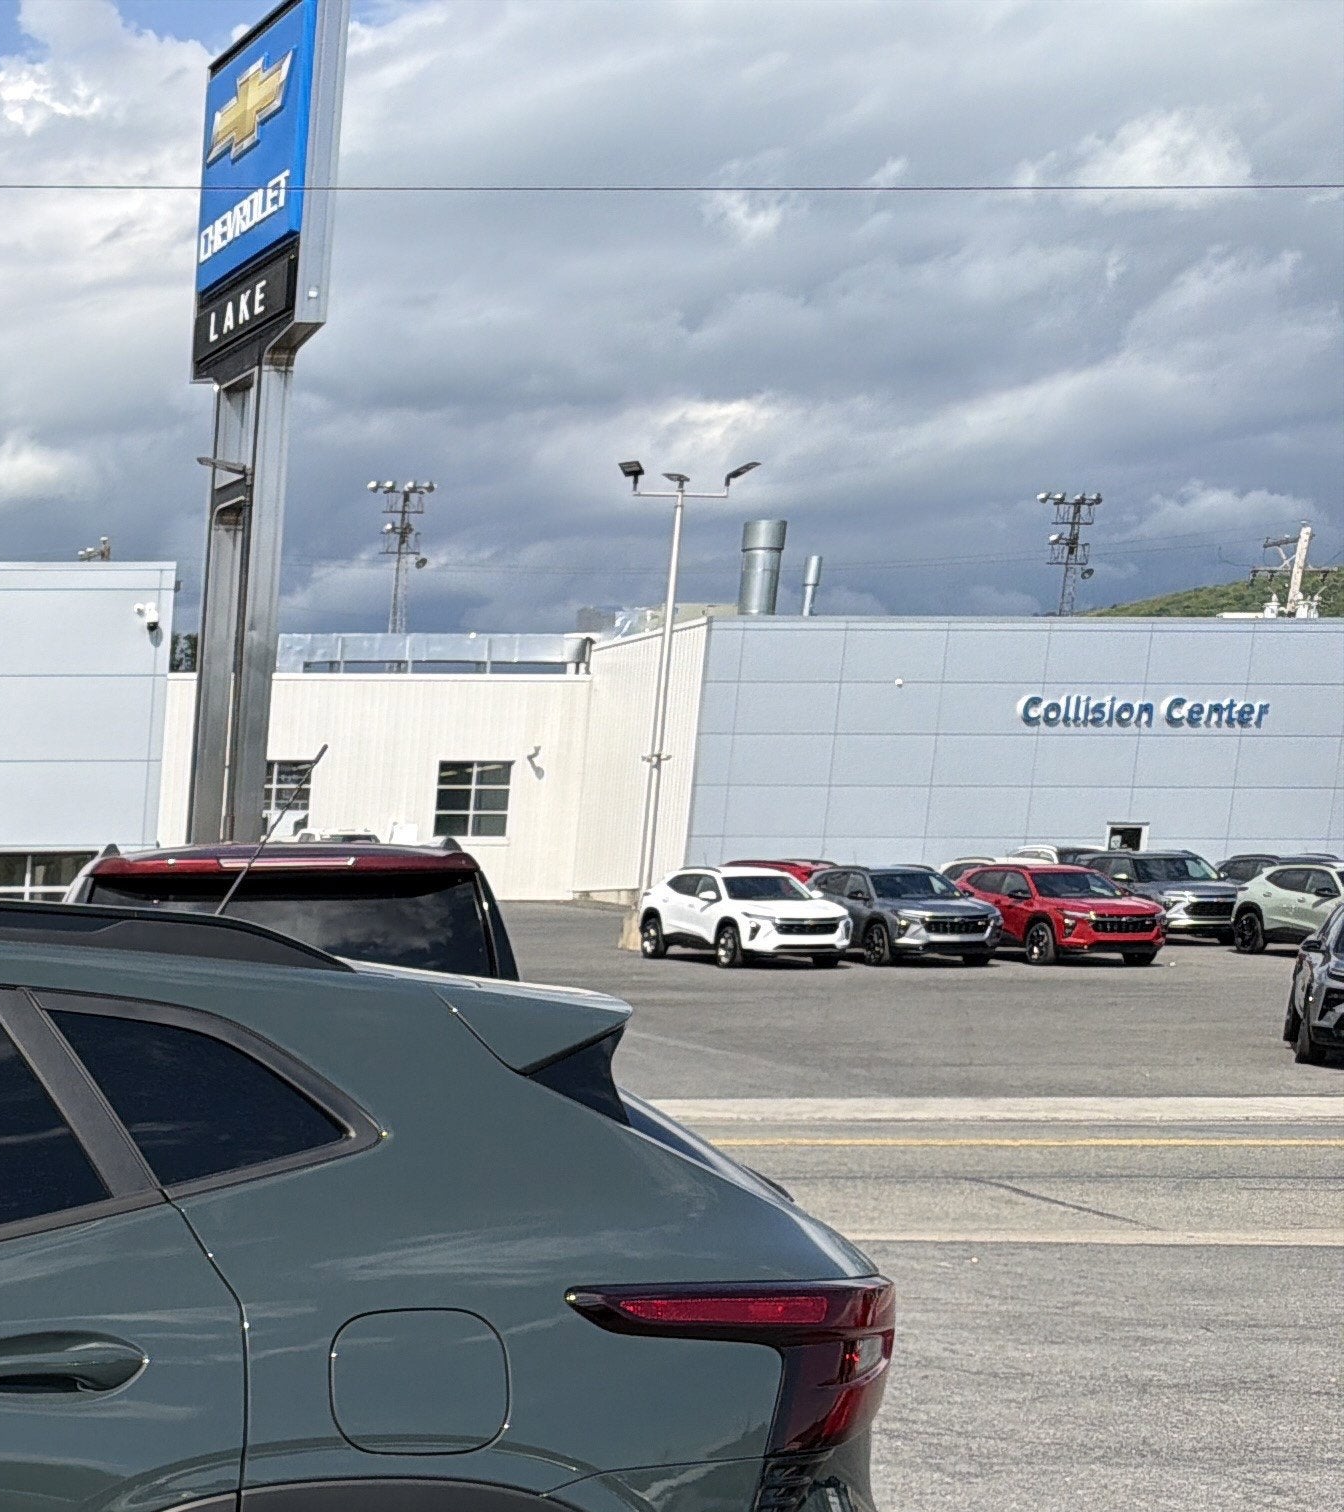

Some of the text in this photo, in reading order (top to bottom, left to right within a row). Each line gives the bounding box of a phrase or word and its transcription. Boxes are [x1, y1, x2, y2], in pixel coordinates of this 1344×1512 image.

[199, 169, 291, 264] CHEVROLET
[209, 280, 267, 343] LAKE
[1020, 695, 1270, 728] Collision Center
